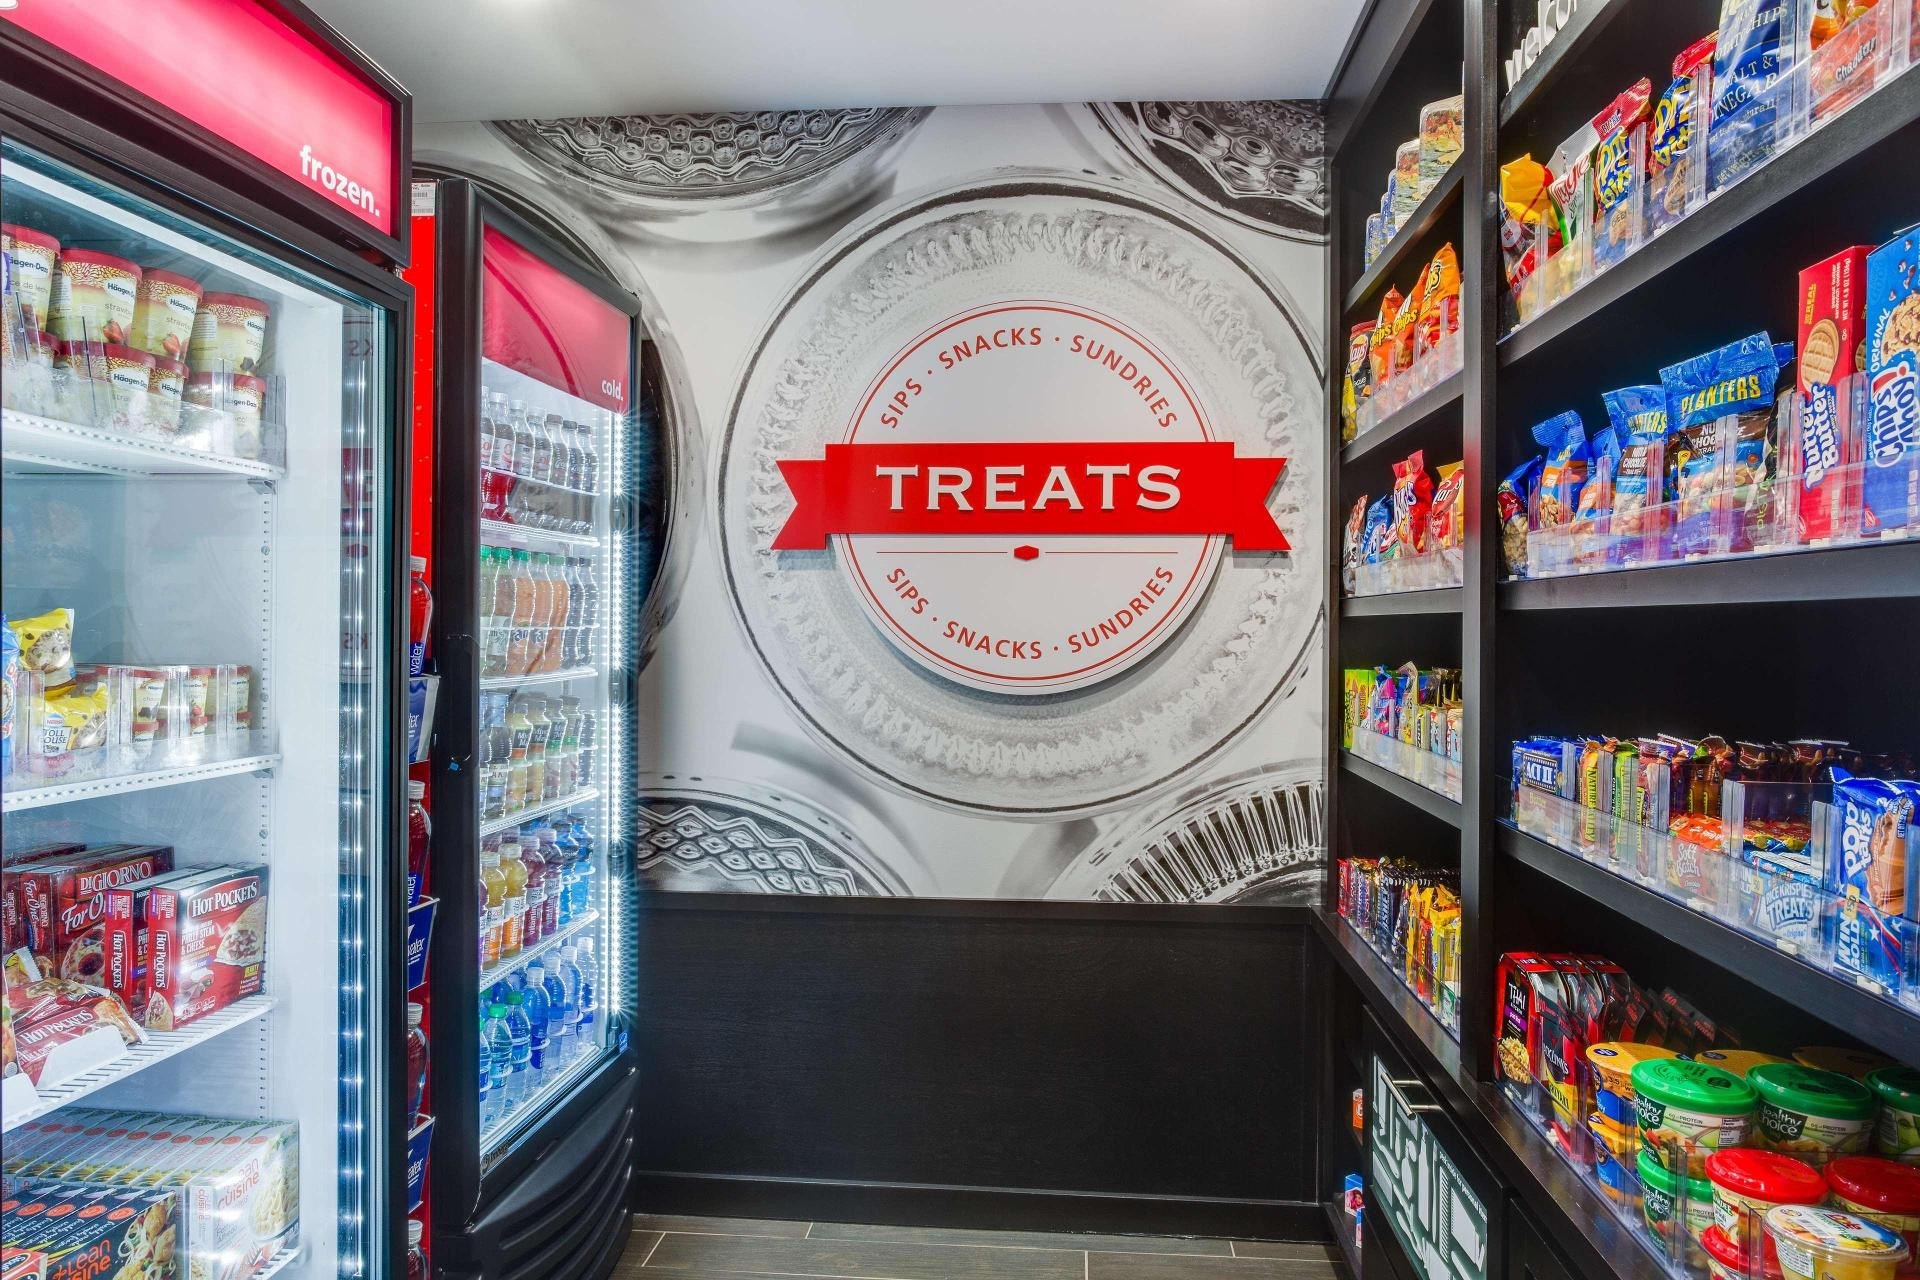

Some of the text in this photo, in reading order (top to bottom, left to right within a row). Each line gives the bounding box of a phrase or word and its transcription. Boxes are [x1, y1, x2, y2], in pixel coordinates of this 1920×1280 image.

[1836, 37, 1877, 82] Cheddar
[300, 145, 380, 217] frozen.
[1870, 307, 1891, 372] ORIGINAL
[601, 378, 623, 401] cold.
[880, 326, 1178, 429] SIPS SNACKS SUNDRIES
[1681, 374, 1761, 419] PLANTERS
[1812, 384, 1839, 469] Butter
[876, 463, 1182, 512] TREATS
[886, 566, 1174, 660] SIPS SNACKS SUNDRIES
[1526, 761, 1553, 785] ACT II
[1587, 767, 1597, 809] NATURE
[61, 903, 88, 934] For
[191, 882, 257, 917] HOT POCKETS
[1766, 898, 1814, 932] TREATS
[155, 933, 166, 988] HOT POCKETS
[1837, 912, 1851, 964] WIN
[1850, 920, 1860, 969] GOLD
[113, 934, 123, 988] HOT POCKETS
[1508, 983, 1526, 1010] THAI
[20, 1009, 94, 1045] HOT POCKETS
[1680, 1115, 1704, 1125] PROTEIN
[67, 1238, 111, 1276] Lean
